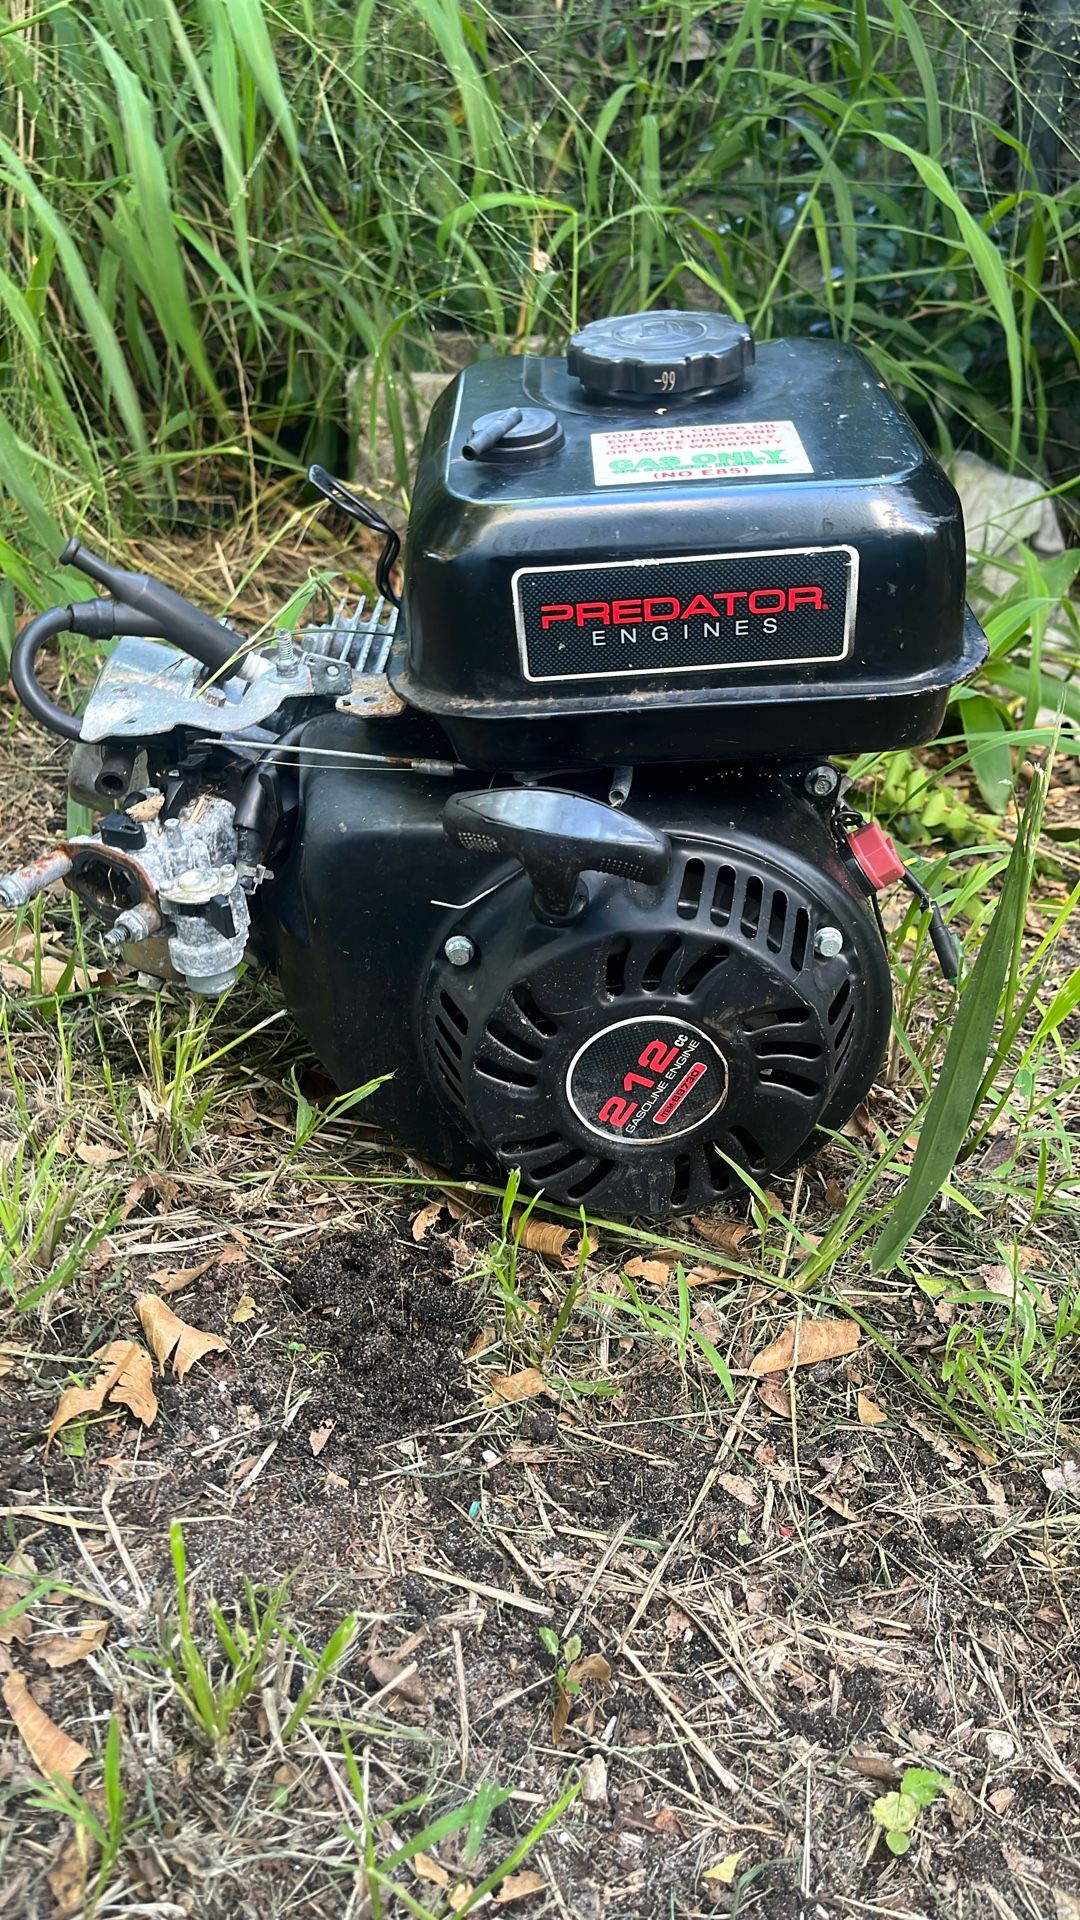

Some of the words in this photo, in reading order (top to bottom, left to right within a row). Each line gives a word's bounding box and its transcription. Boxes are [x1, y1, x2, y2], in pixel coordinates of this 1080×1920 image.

[607, 436, 659, 444] EVERY
[680, 431, 737, 439] HOURS
[691, 424, 747, 433] CHECK
[610, 439, 684, 449] OPERATE
[691, 434, 774, 443] PROPERLY
[633, 446, 684, 454] VOIDS
[689, 439, 782, 449] WARRANTY
[608, 455, 682, 471] GAS
[691, 448, 785, 465] ONLY
[653, 470, 693, 480] (NO
[701, 466, 750, 476] E85)
[540, 585, 826, 630] PREDATOR
[591, 617, 778, 647] ENGINES
[598, 1038, 681, 1129] 212
[625, 1080, 669, 1134] GASOLINE
[665, 1038, 701, 1080] ENGINE
